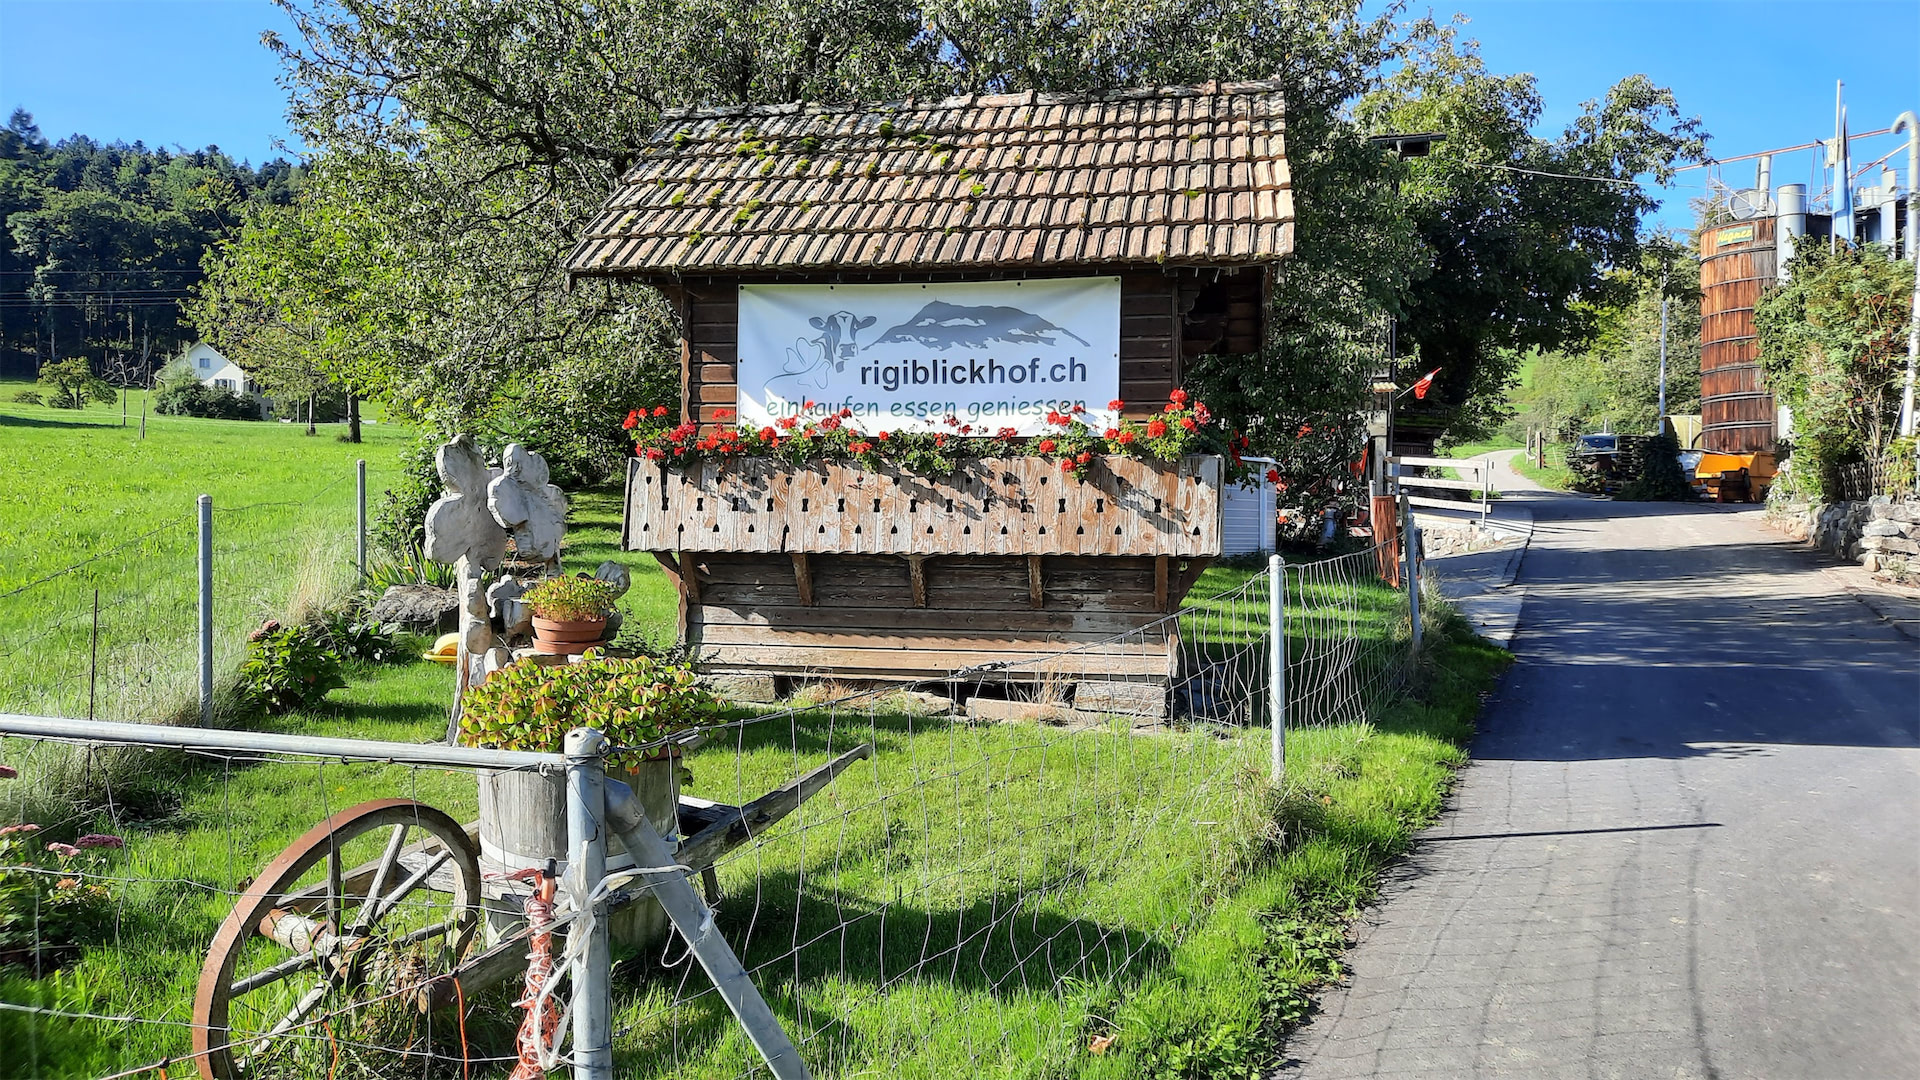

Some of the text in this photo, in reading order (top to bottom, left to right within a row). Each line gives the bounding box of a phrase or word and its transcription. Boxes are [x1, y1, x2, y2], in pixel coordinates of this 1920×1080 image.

[861, 357, 1087, 392] rigiblickhof.ch
[890, 401, 956, 417] essen
[967, 396, 1086, 423] geniessen
